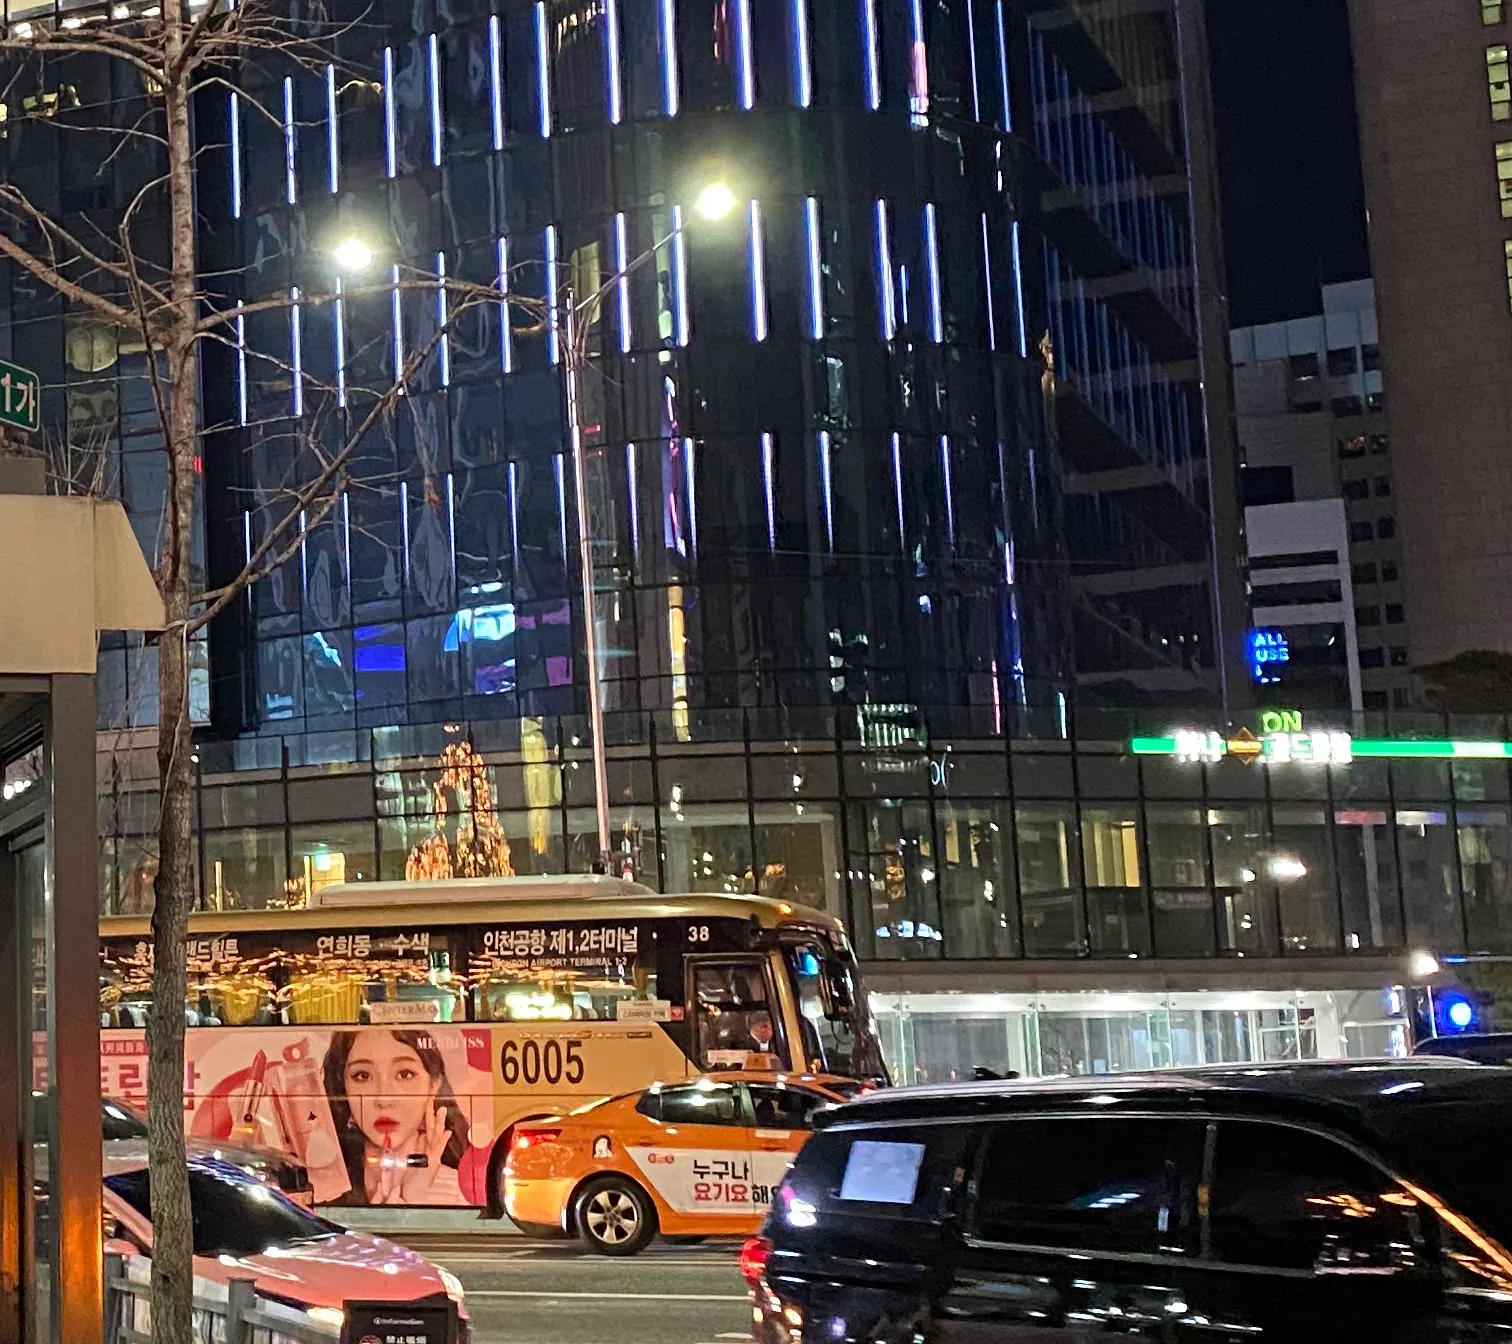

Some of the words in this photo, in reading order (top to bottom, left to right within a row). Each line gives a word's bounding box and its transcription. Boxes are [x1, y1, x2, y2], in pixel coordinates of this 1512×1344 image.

[316, 934, 371, 958] 연희동
[391, 932, 431, 955] 수색
[483, 929, 547, 957] 인천공항
[550, 925, 638, 955] 제1,2터미널
[688, 926, 710, 942] 38
[500, 1040, 585, 1085] 6005
[692, 1159, 749, 1182] 누구나
